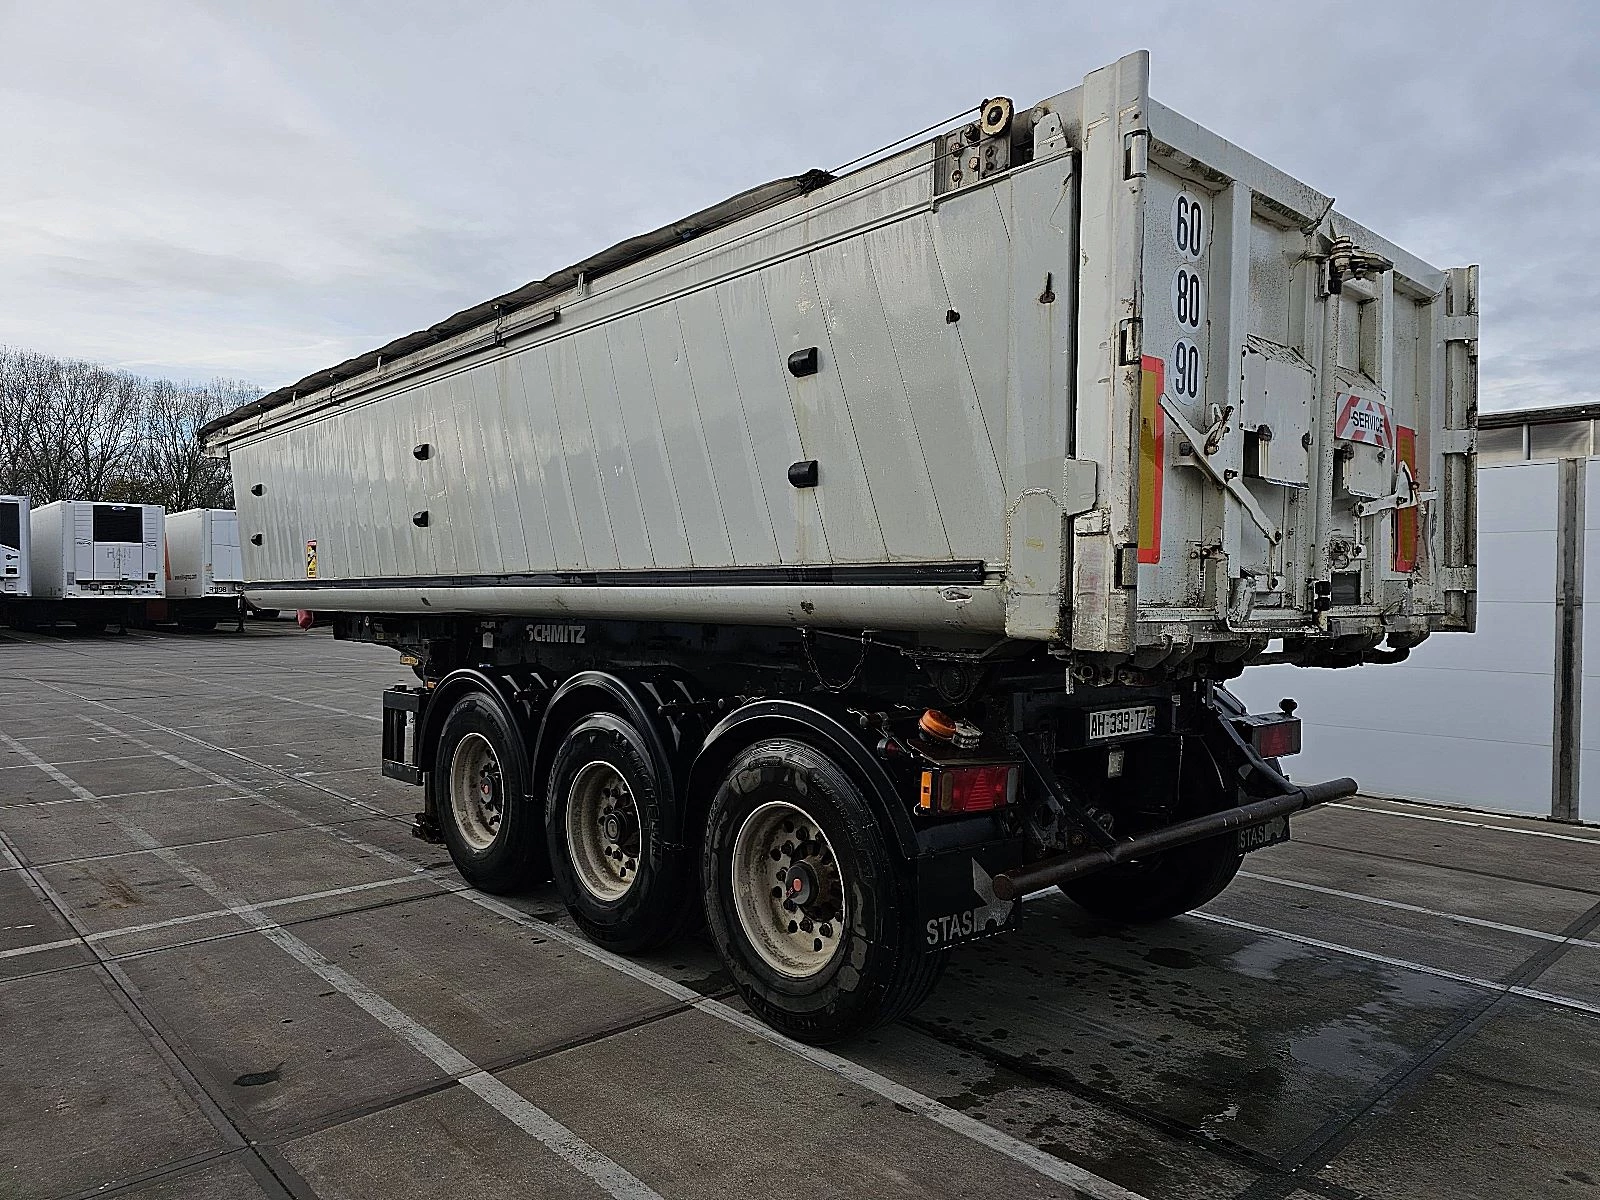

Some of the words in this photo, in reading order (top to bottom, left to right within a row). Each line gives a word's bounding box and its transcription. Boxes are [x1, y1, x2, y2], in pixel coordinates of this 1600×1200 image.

[1177, 196, 1201, 256] 60
[1177, 270, 1200, 327] 80
[1176, 342, 1199, 398] 90
[1351, 410, 1384, 433] SERVICE
[526, 624, 586, 644] SCHMITZ
[1240, 825, 1264, 849] STAS
